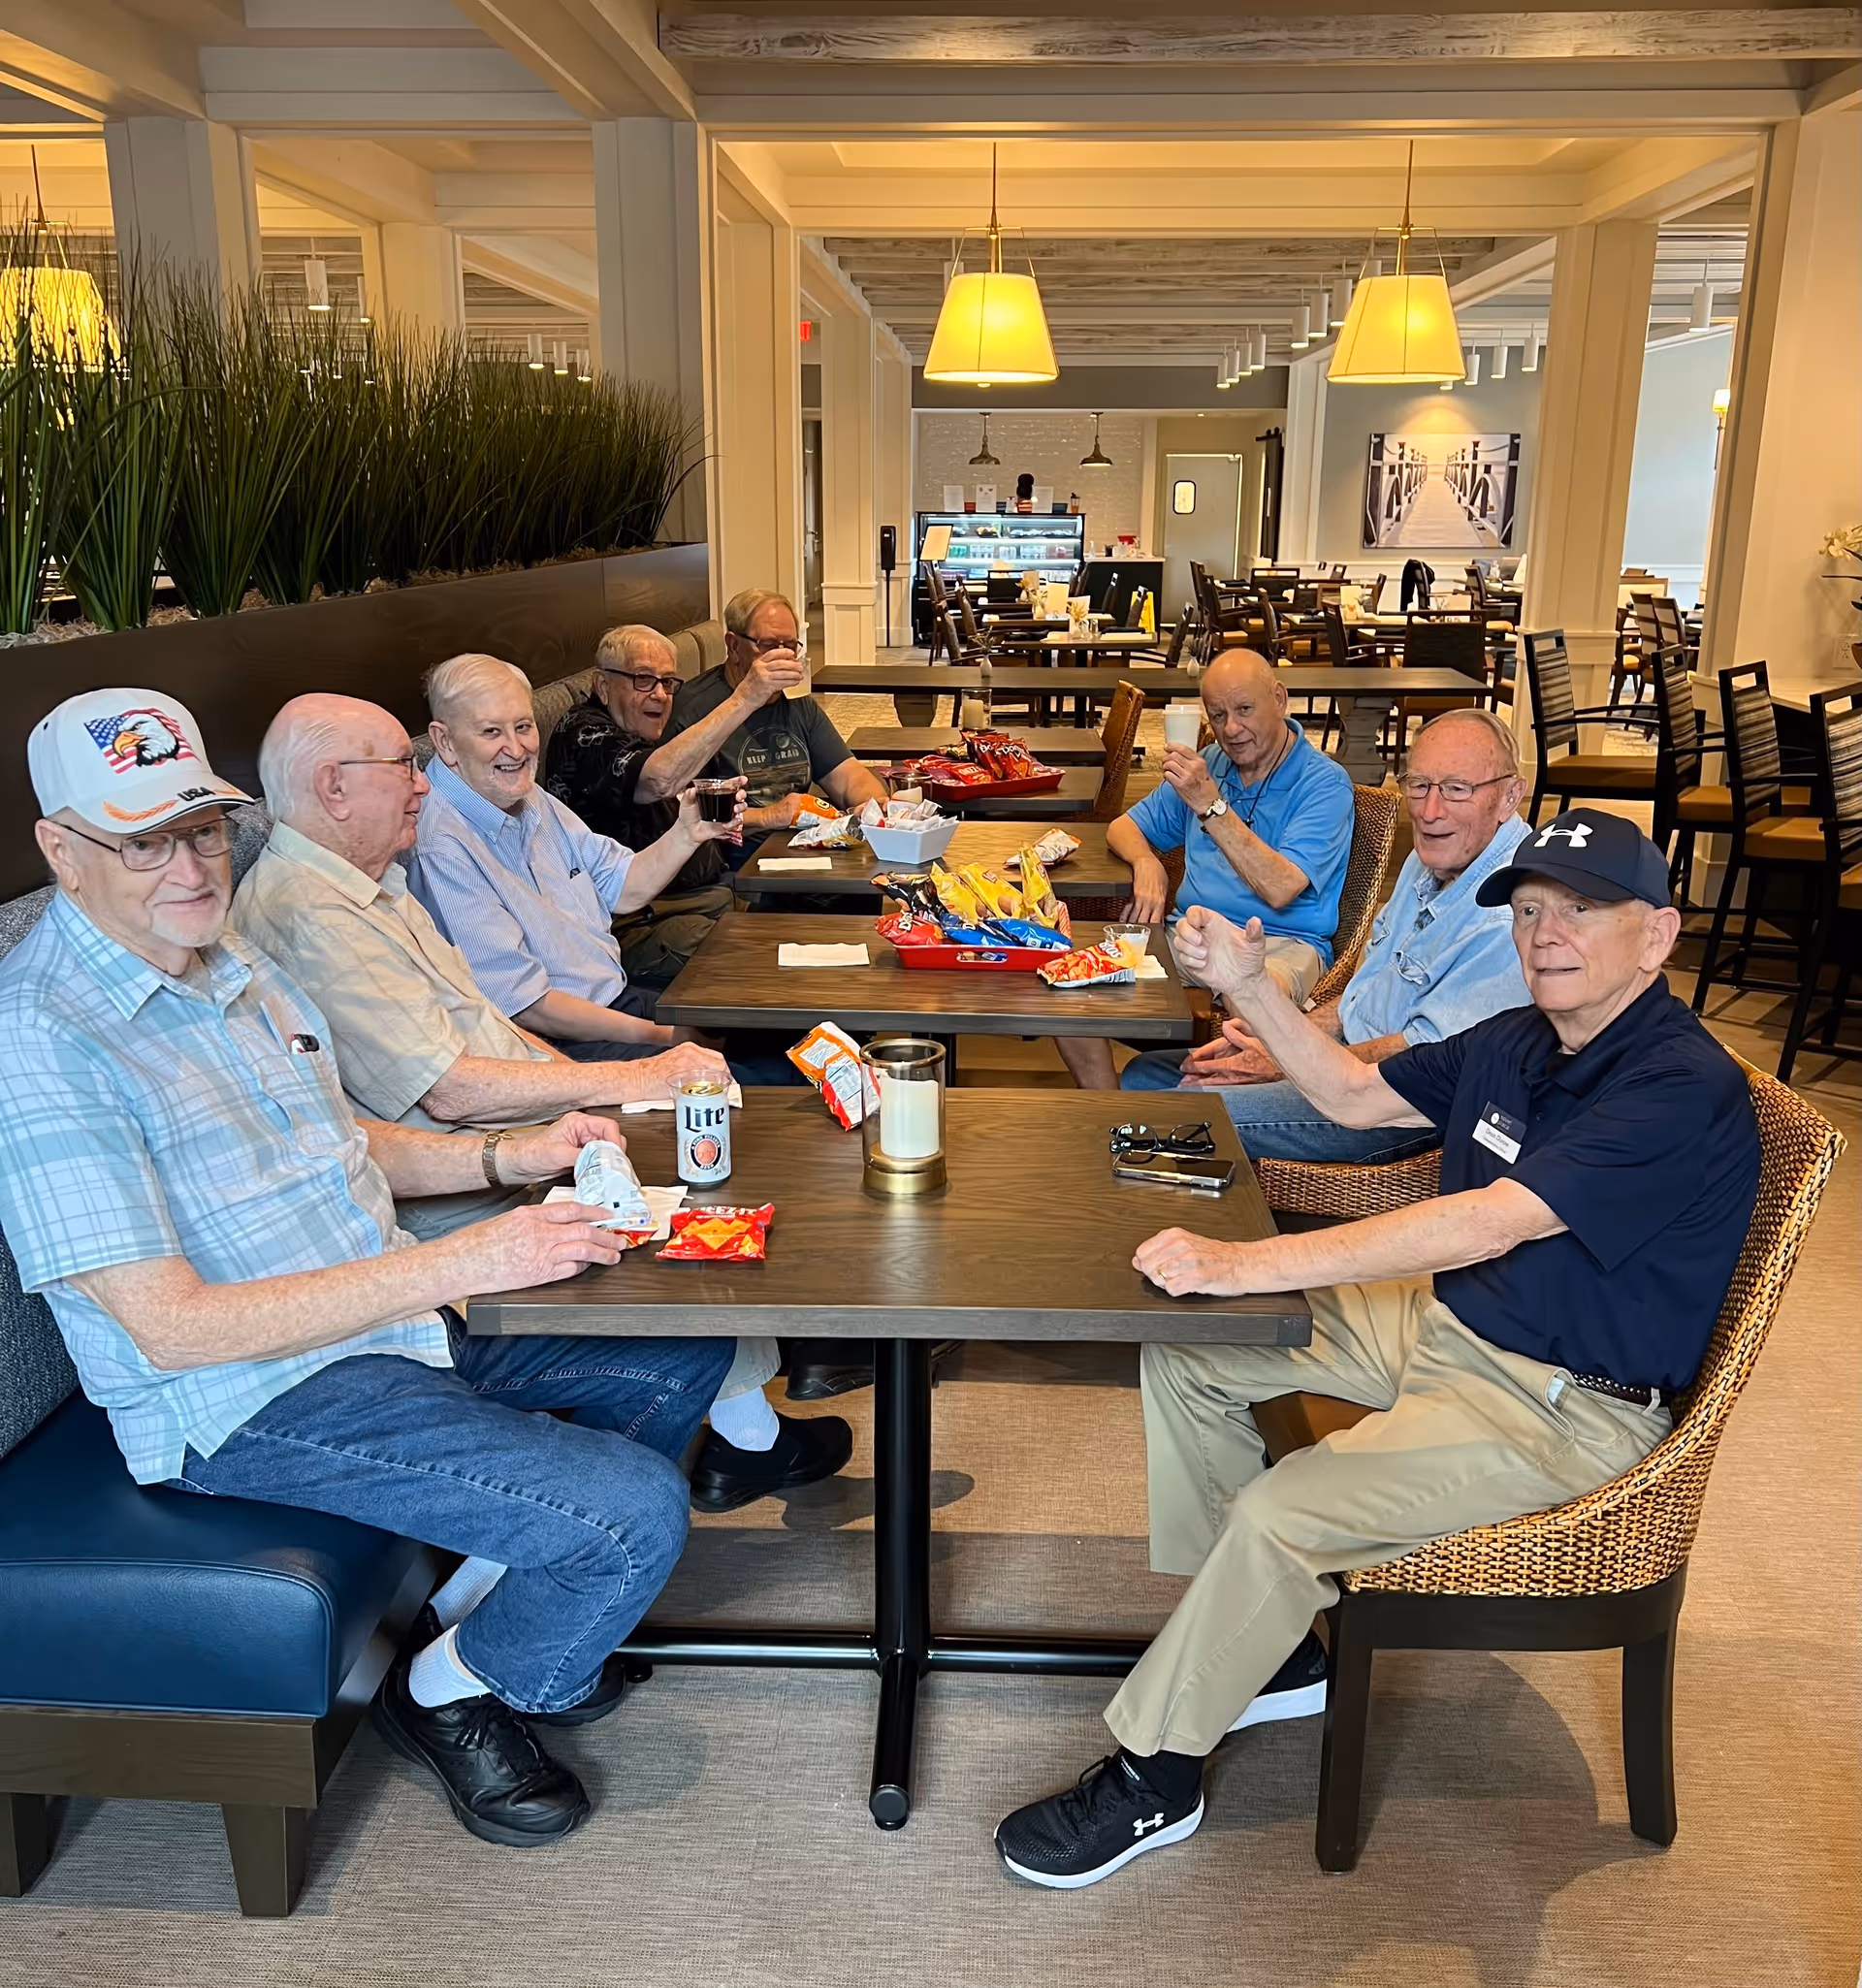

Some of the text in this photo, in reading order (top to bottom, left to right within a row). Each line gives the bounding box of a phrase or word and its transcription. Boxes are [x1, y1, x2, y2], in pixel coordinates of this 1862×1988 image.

[746, 754, 766, 764] KEEP
[177, 786, 216, 802] USA
[685, 1106, 724, 1133] Lite
